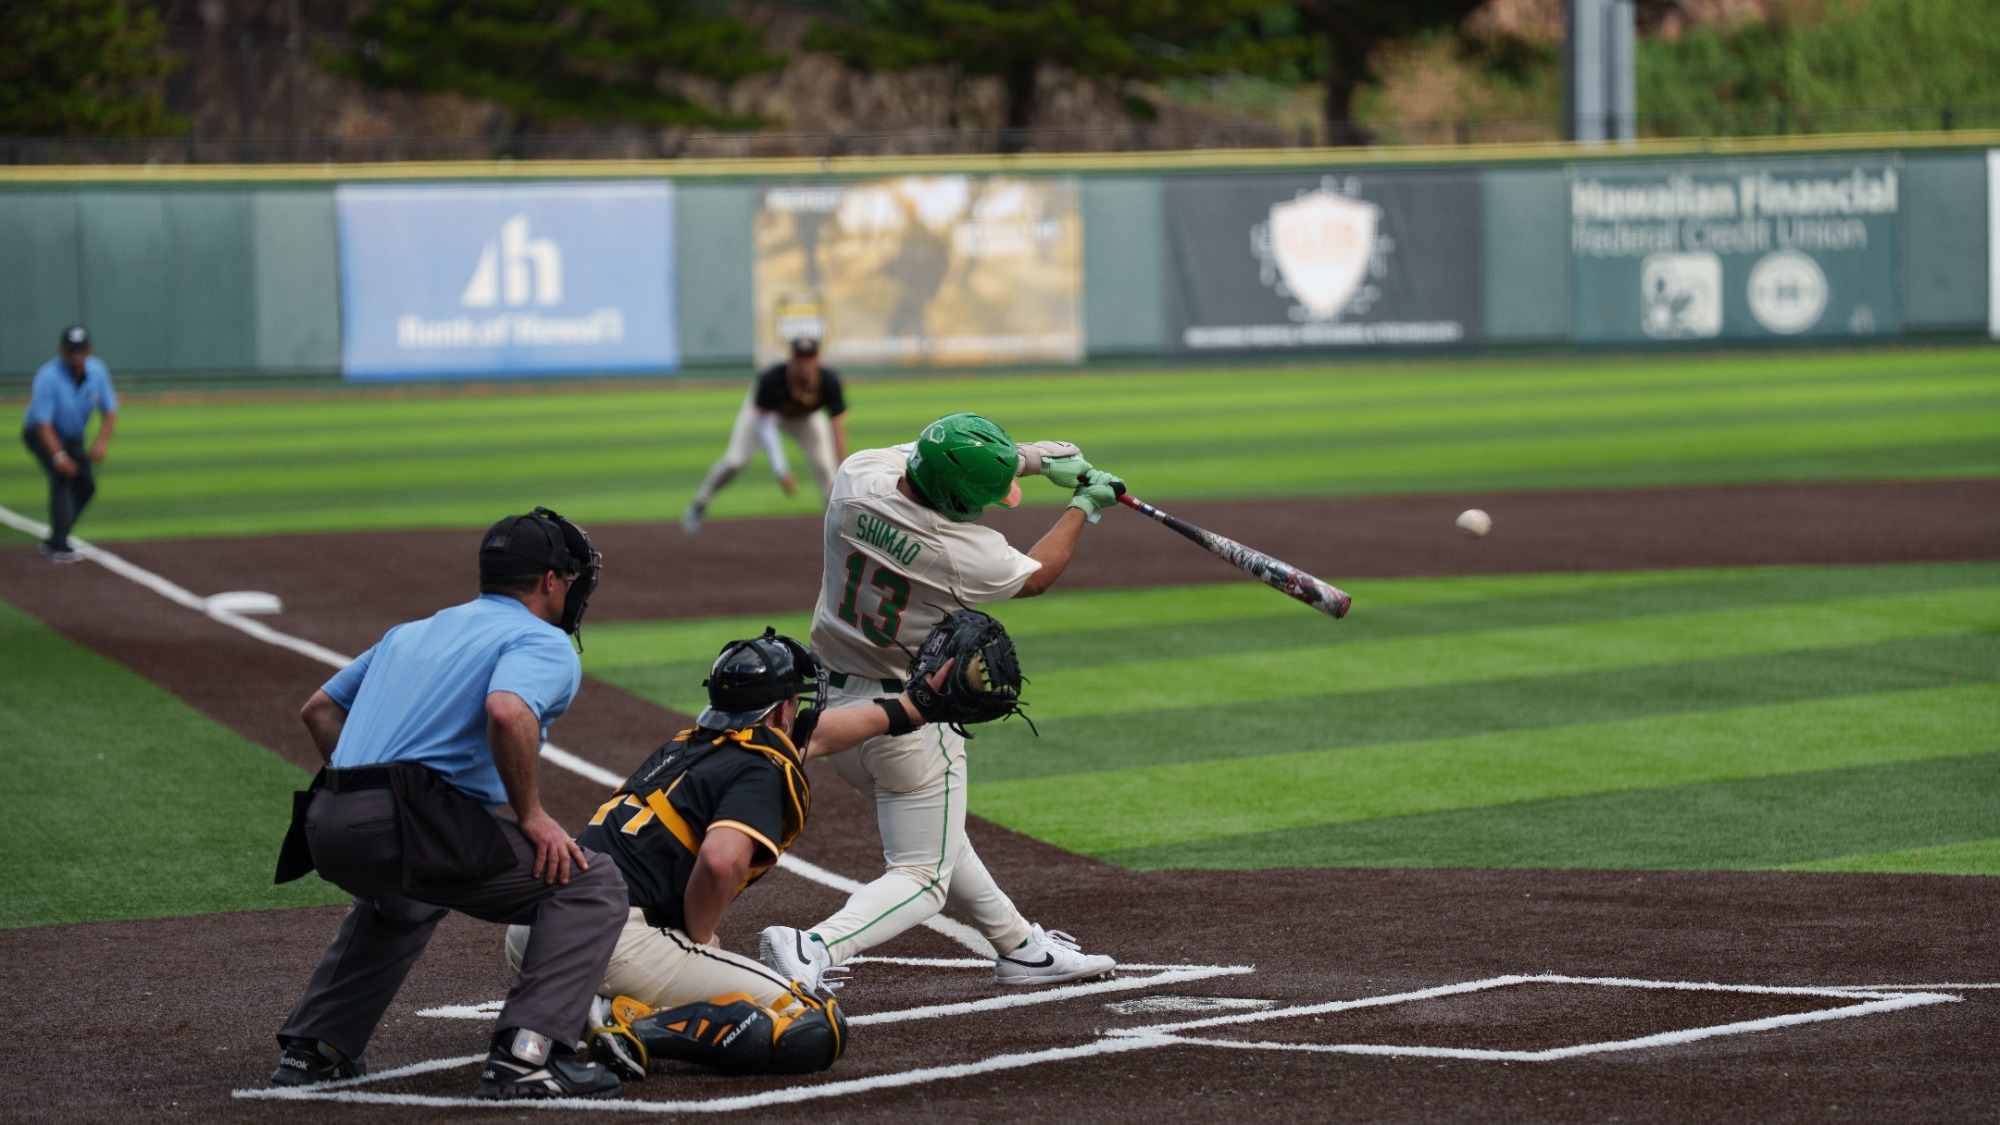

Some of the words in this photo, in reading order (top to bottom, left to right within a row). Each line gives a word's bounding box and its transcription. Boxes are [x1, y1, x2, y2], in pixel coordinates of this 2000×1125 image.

[1571, 175, 1738, 218] Hawaiian
[1740, 167, 1899, 214] Financial
[1571, 216, 1679, 256] Federal
[1682, 215, 1772, 253] Credit
[1776, 211, 1868, 250] Union
[857, 514, 922, 566] SHIMAO
[838, 552, 912, 649] 13
[721, 1010, 758, 1048] EASTON
